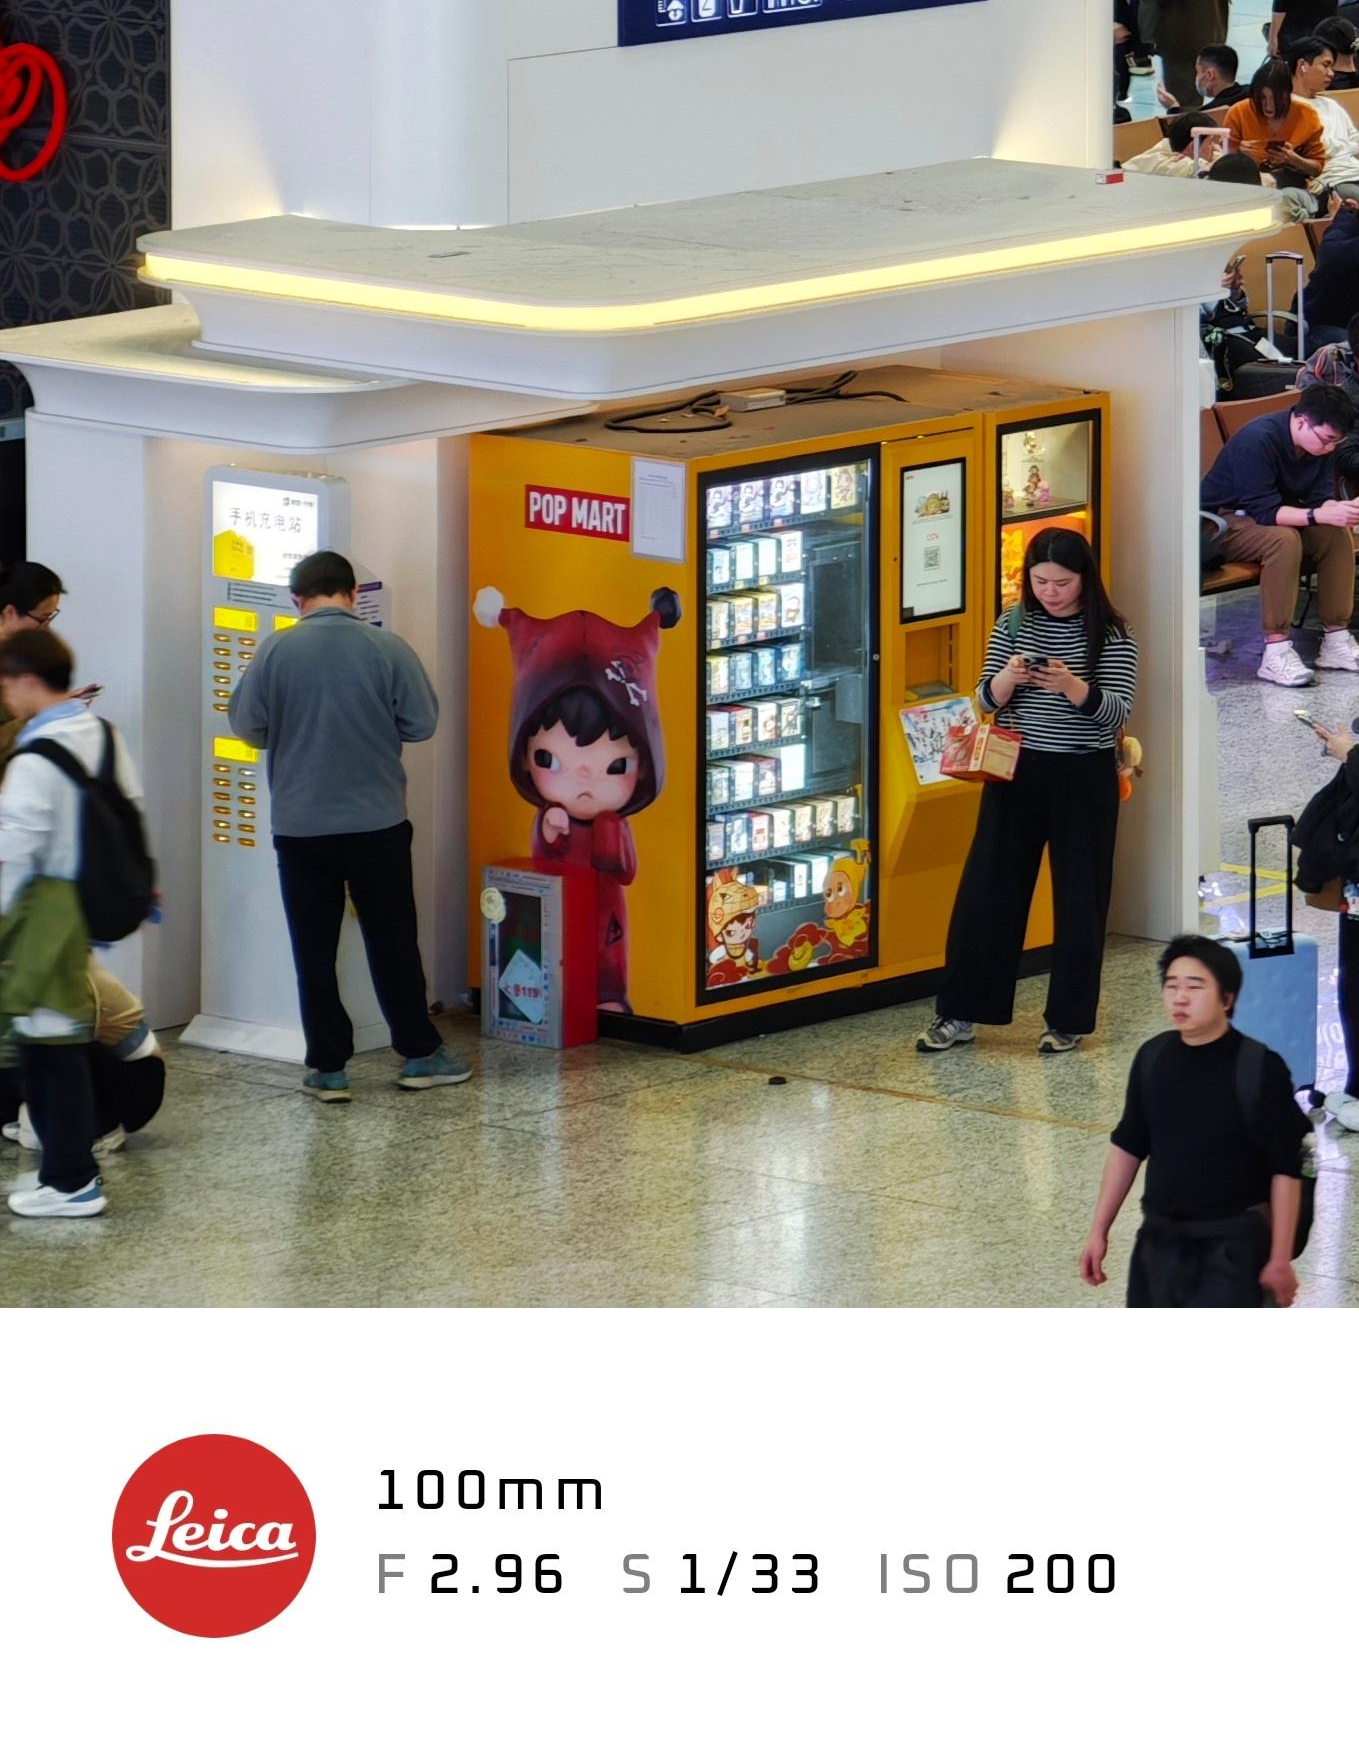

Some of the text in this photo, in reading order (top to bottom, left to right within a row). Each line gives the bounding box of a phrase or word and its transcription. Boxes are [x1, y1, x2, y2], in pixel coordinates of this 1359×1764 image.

[229, 507, 303, 534] 手机充电站
[529, 490, 565, 526] POP
[571, 497, 627, 535] MART
